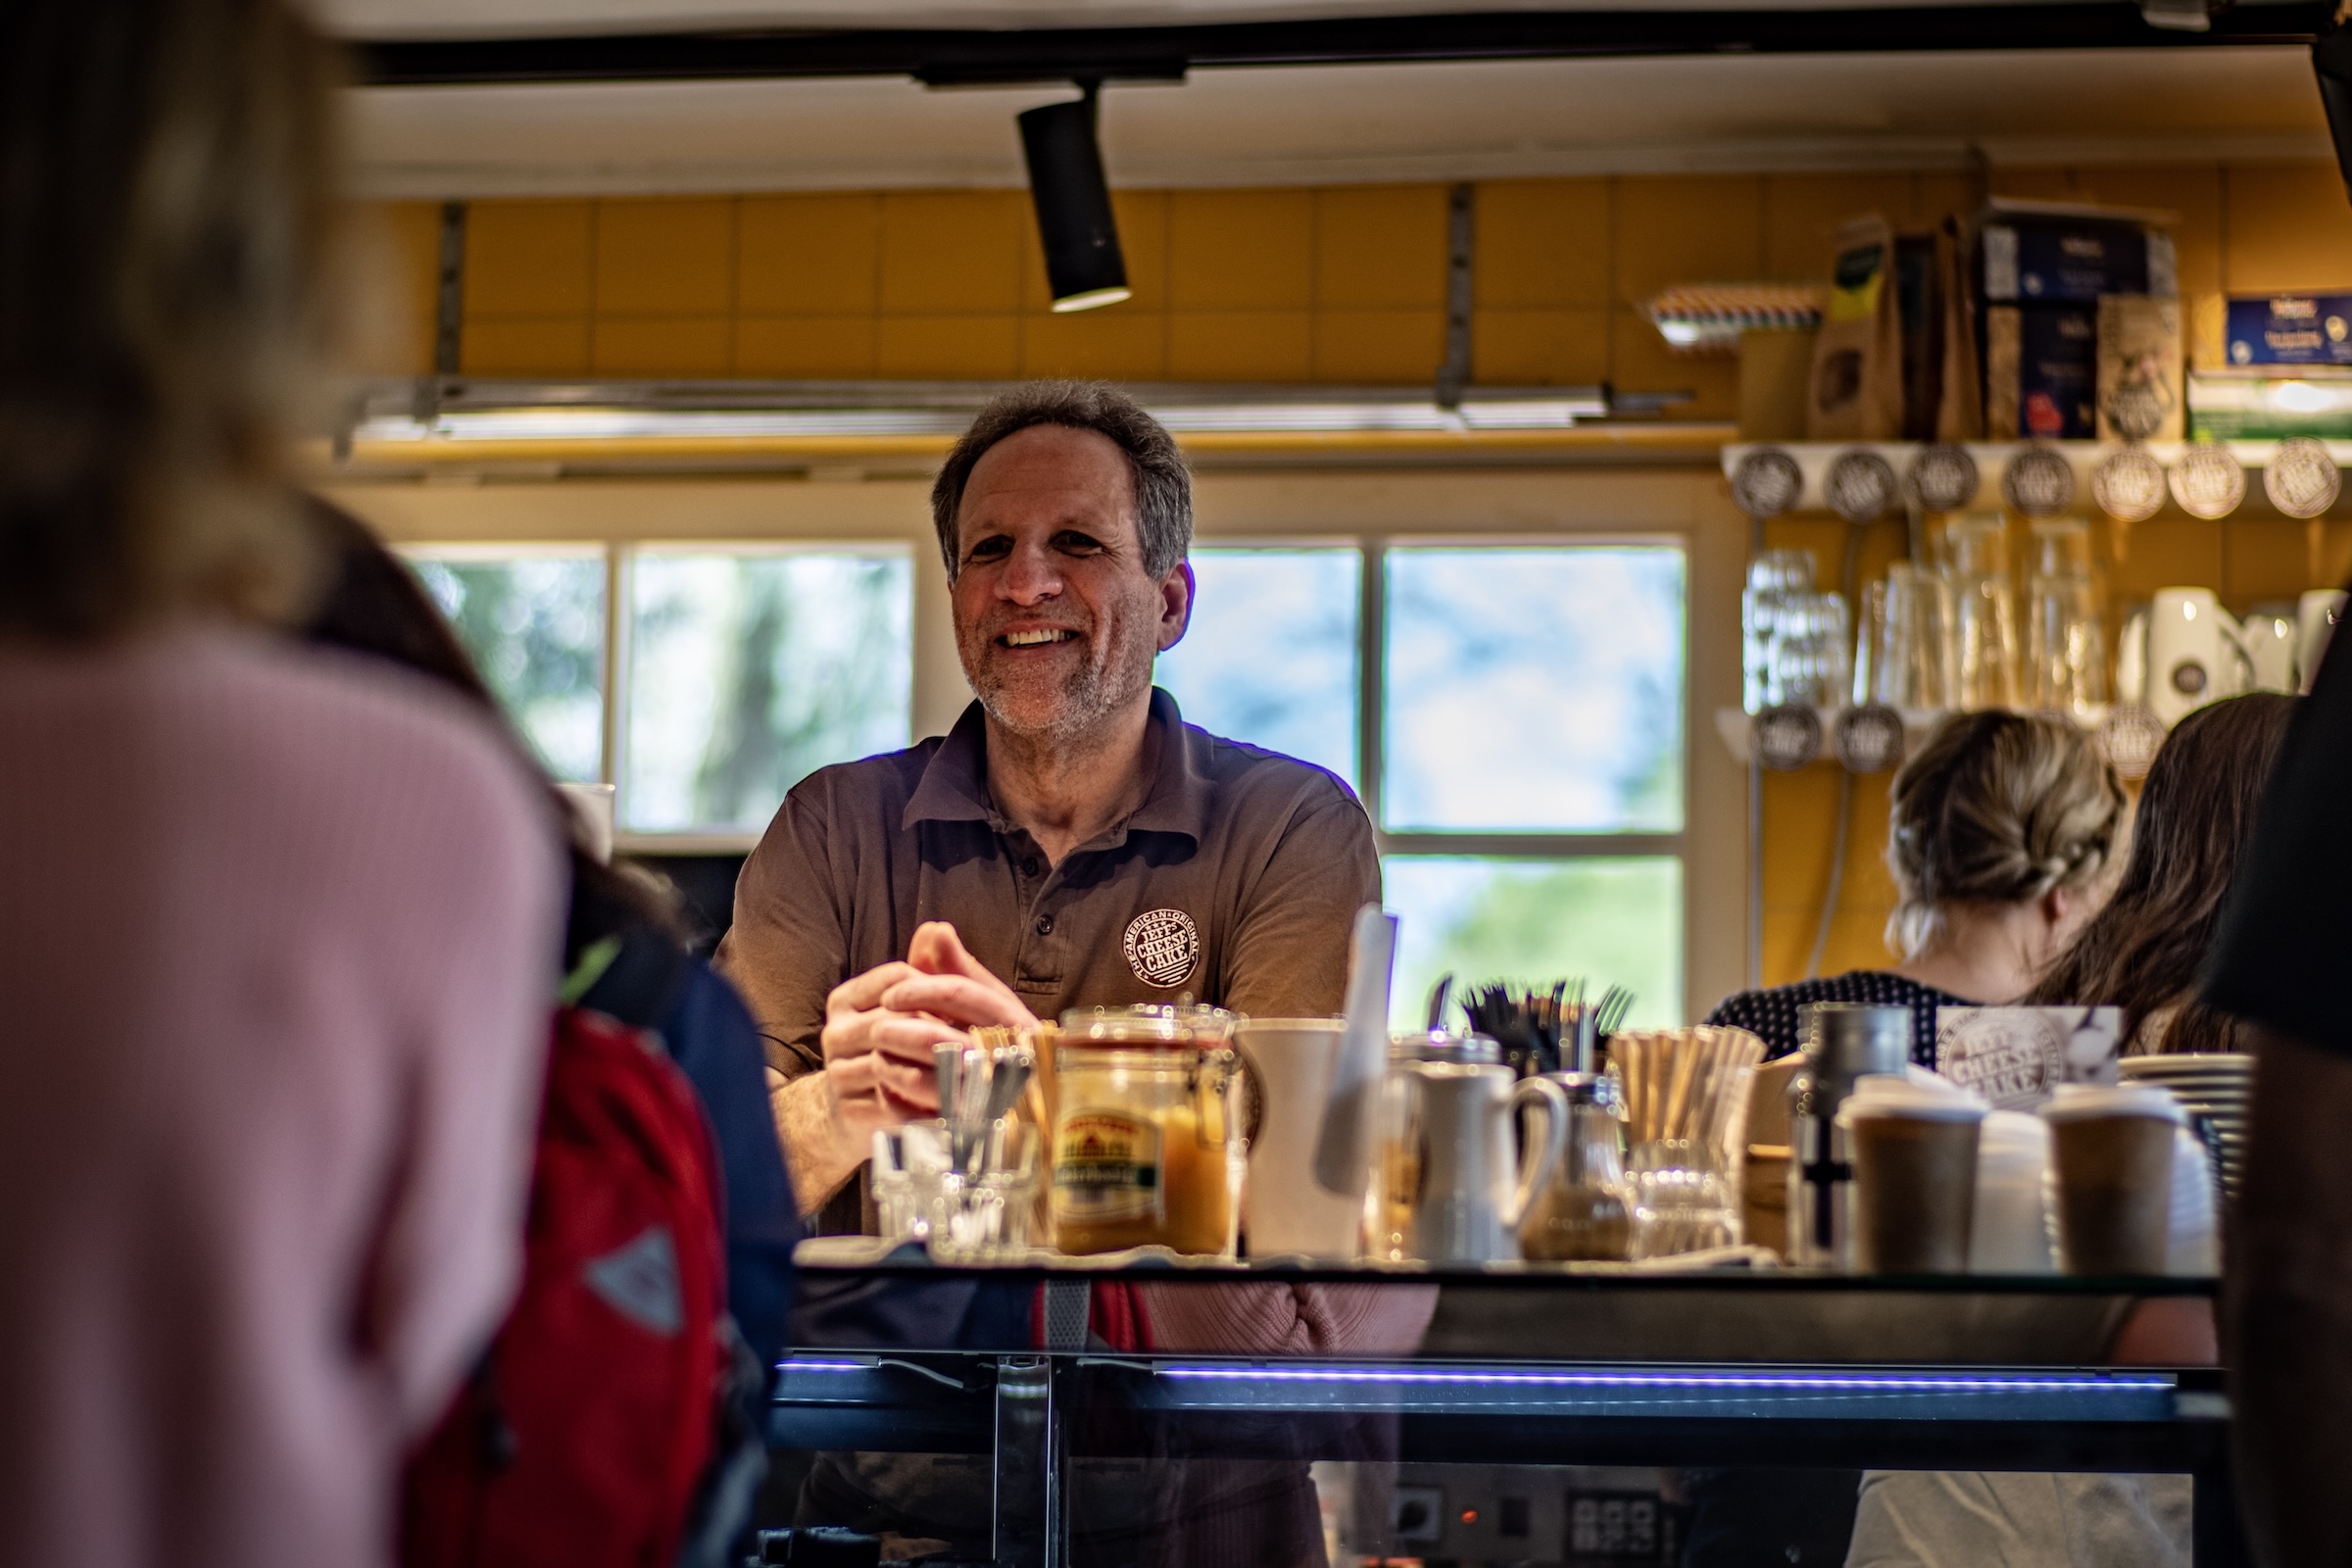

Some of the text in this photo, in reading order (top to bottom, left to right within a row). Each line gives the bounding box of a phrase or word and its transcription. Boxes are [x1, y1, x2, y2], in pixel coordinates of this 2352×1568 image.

[1125, 911, 1199, 977] THE AMERICAN ORIGINAL
[1137, 929, 1189, 958] CHEESE
[1145, 945, 1188, 971] CAKE
[1951, 1045, 2043, 1085] CHEESE
